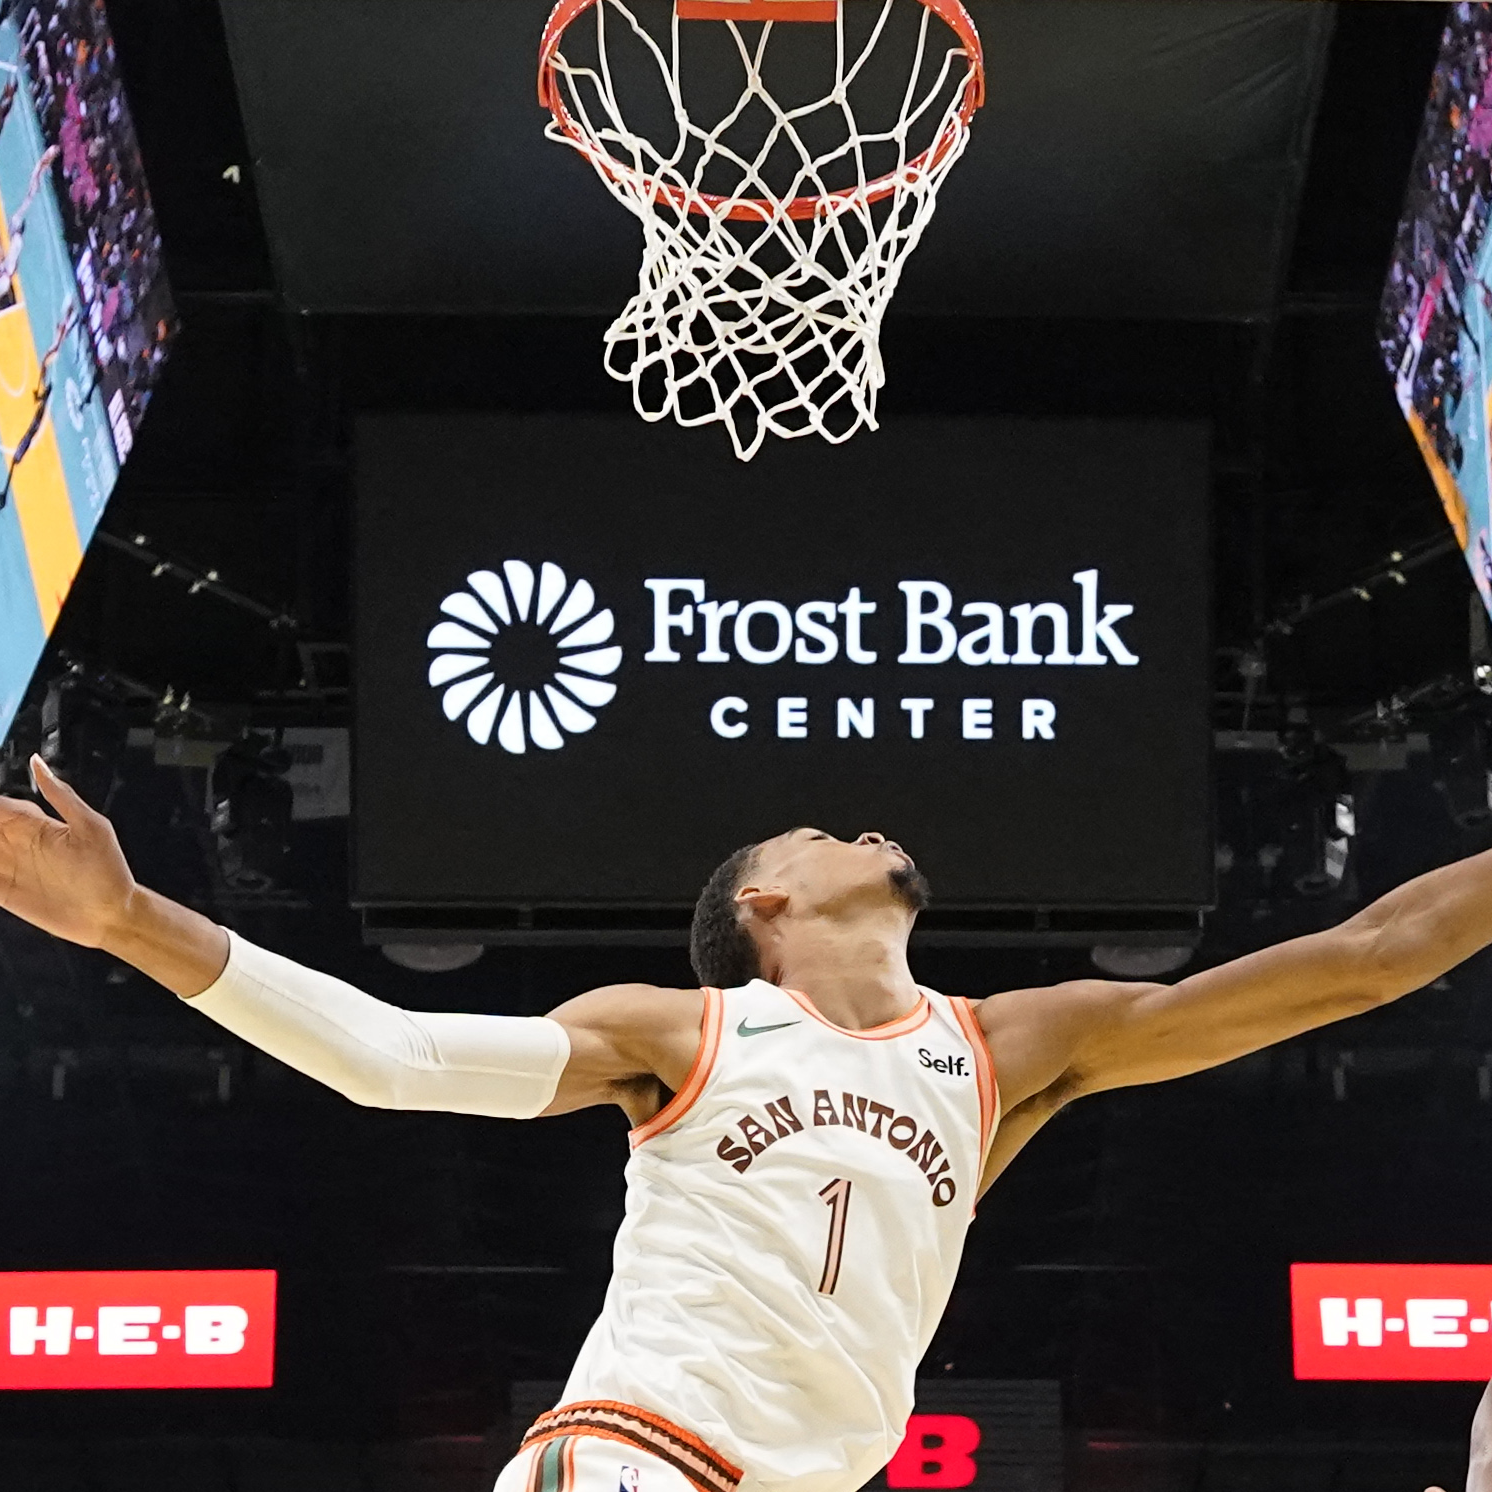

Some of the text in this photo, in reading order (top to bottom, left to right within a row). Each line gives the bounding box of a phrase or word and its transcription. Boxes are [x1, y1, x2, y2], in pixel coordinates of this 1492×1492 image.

[644, 568, 1140, 666] Frost Bank
[710, 696, 1057, 740] CENTER
[918, 1048, 969, 1076] Self.
[716, 1089, 956, 1208] SAN ANTONIO
[818, 1178, 852, 1295] 1
